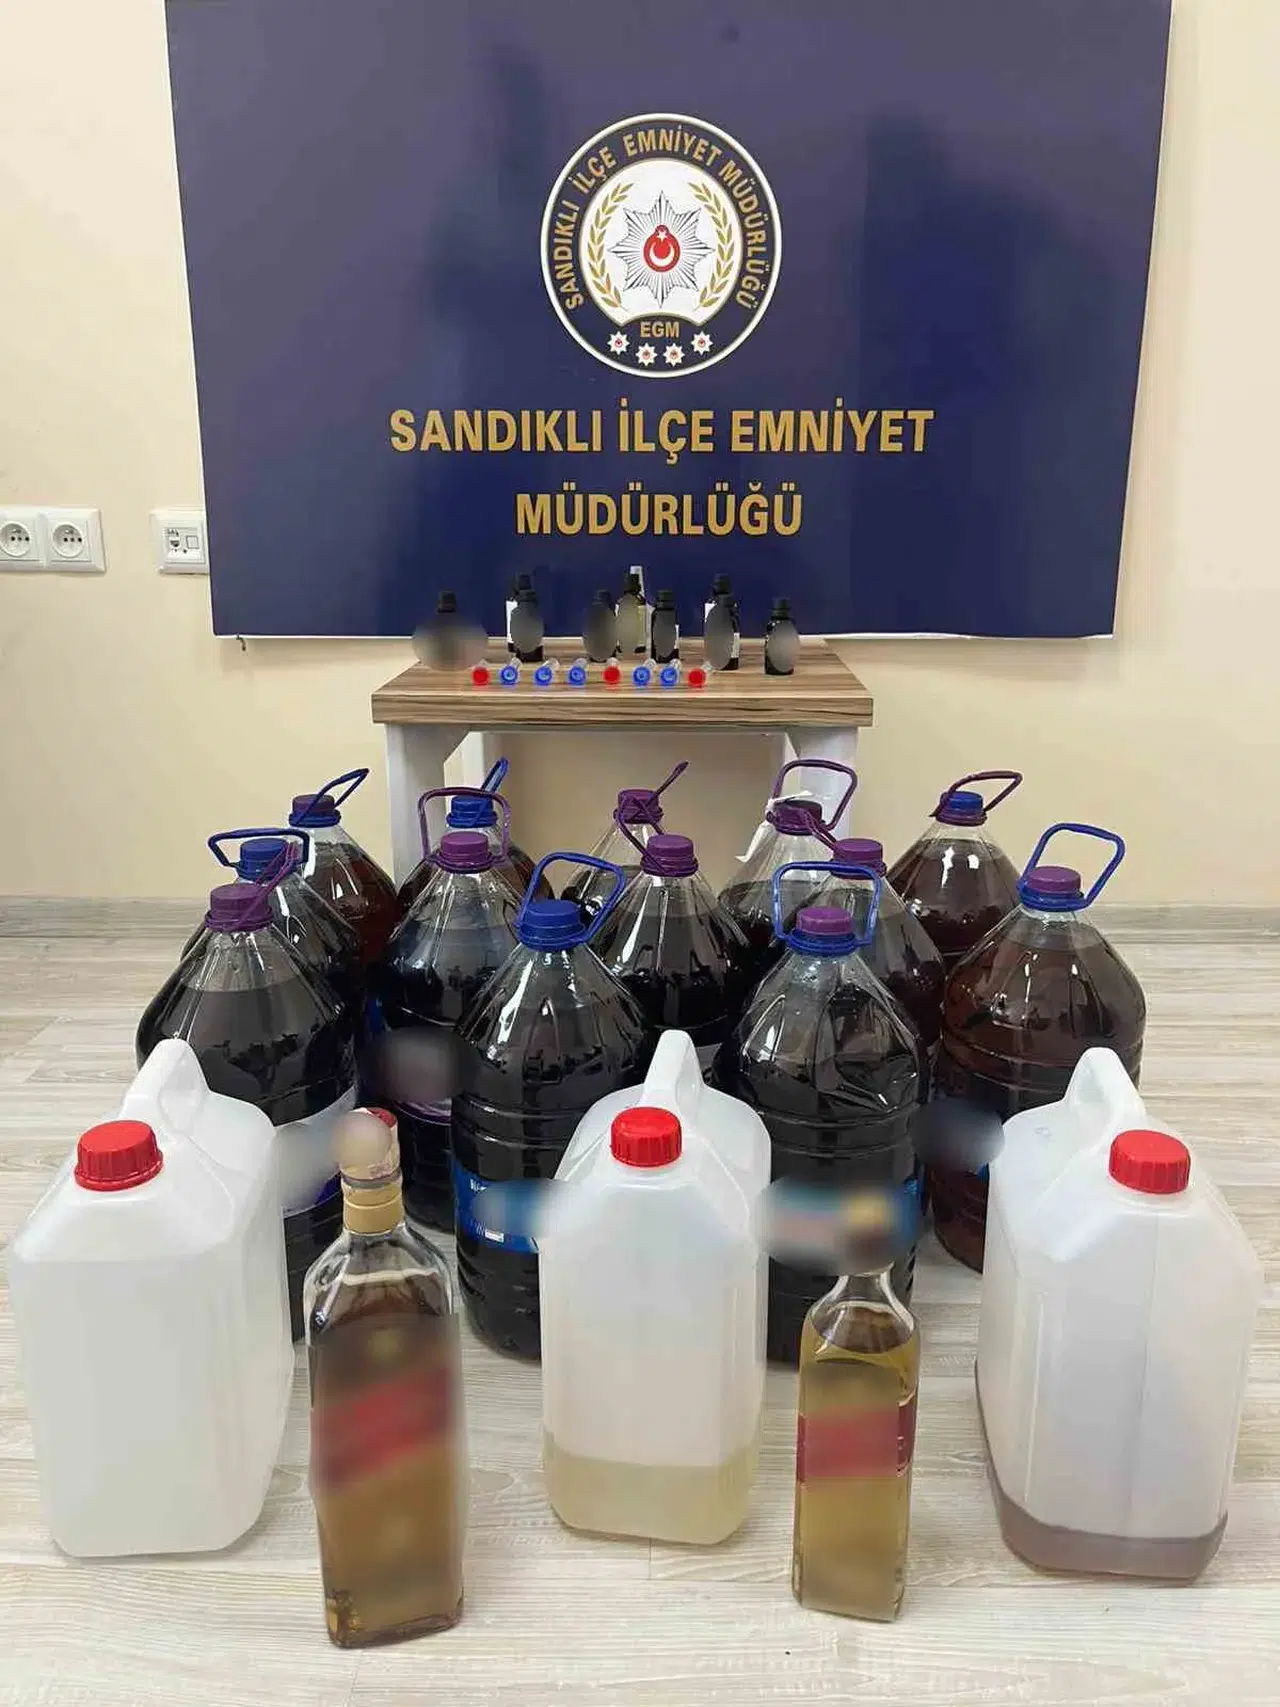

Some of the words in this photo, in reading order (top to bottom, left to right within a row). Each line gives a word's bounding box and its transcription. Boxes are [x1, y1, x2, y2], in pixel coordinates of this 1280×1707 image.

[553, 200, 584, 310] SANDIKLI
[569, 147, 616, 193] İLÇE
[623, 126, 722, 167] EMNİYET
[719, 160, 769, 308] MÜDÜRLÜĞÜ
[639, 321, 680, 338] EGM
[390, 409, 602, 452] SANDIKLI
[619, 397, 714, 465] İLÇE
[731, 397, 934, 453] EMNİYET
[516, 482, 802, 536] MÜDÜRLÜĞÜ
